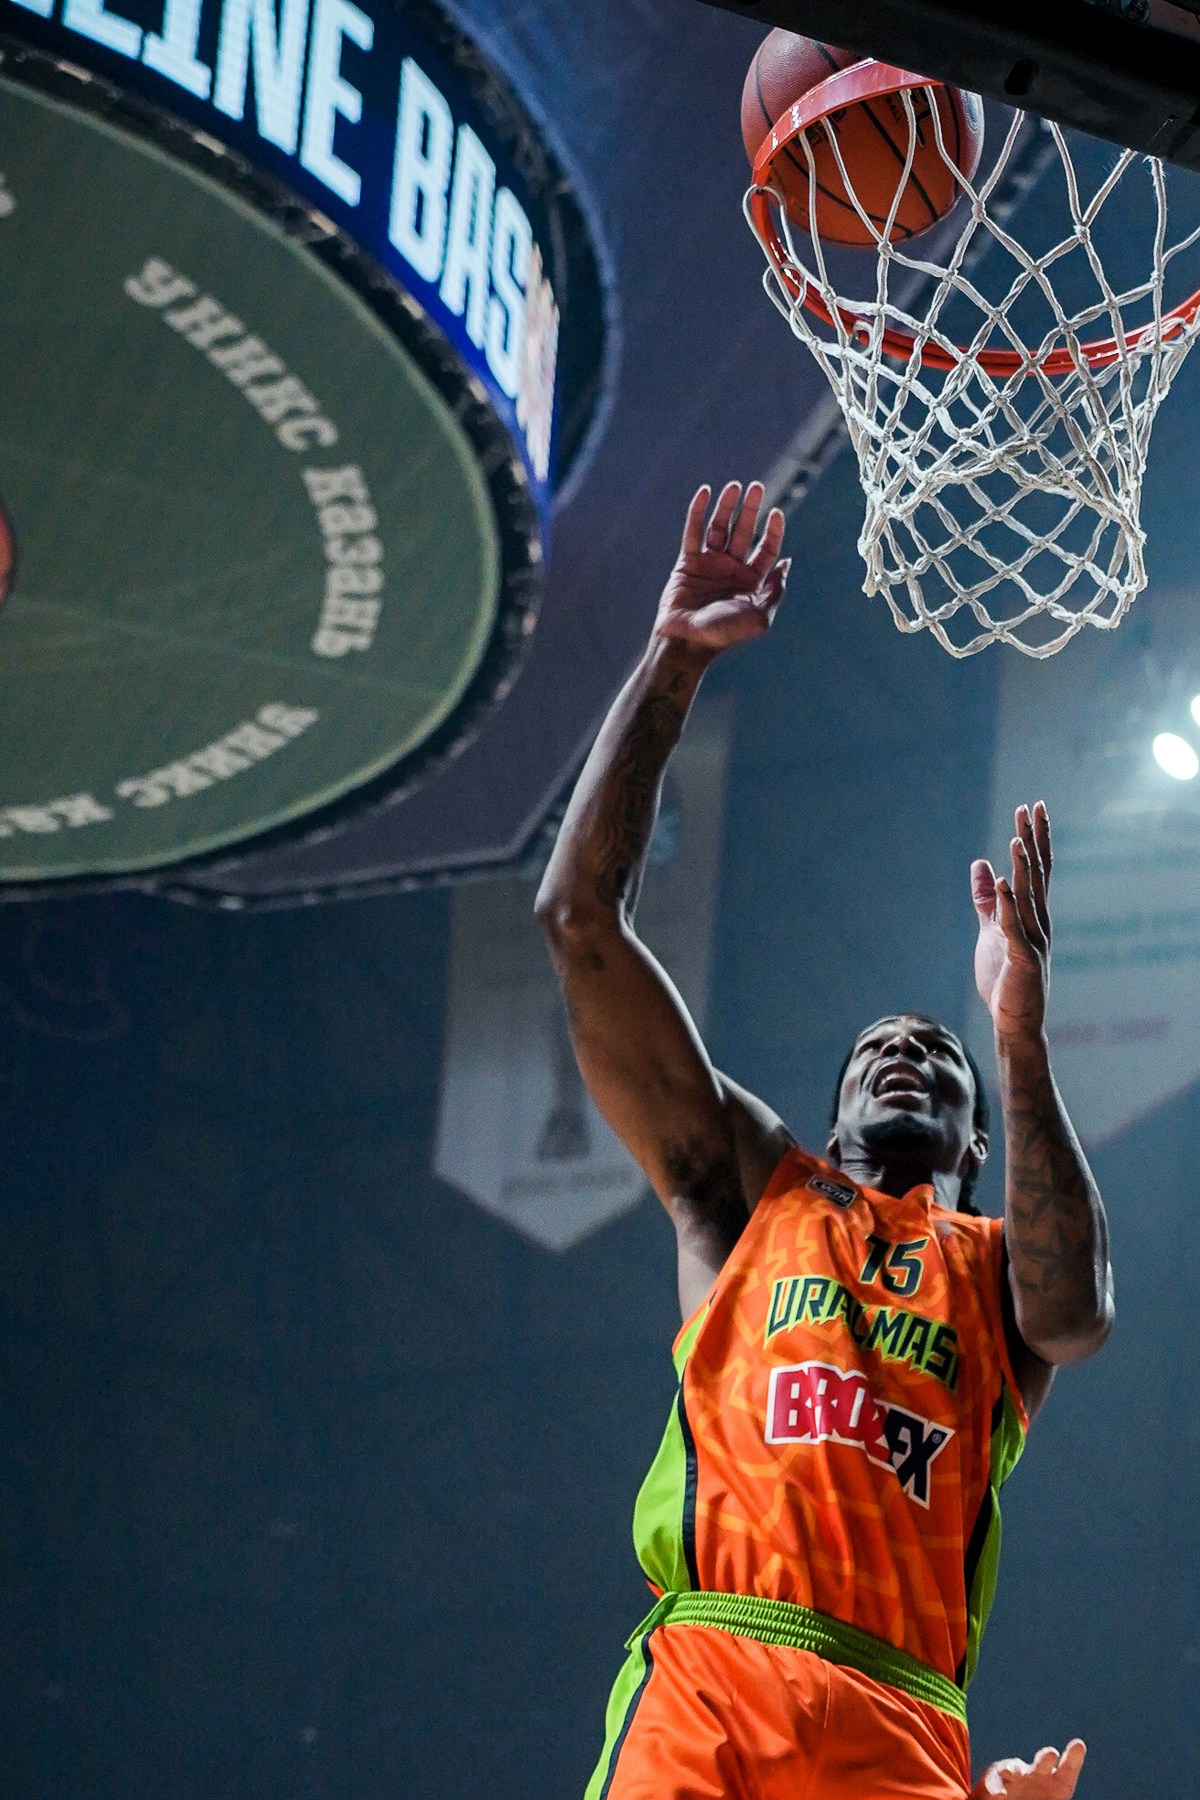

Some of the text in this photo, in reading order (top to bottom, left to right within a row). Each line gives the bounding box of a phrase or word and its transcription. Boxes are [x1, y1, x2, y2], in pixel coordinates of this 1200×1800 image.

[10, 0, 374, 206] INE
[860, 1234, 930, 1298] 15
[763, 1275, 959, 1391] URALMAS
